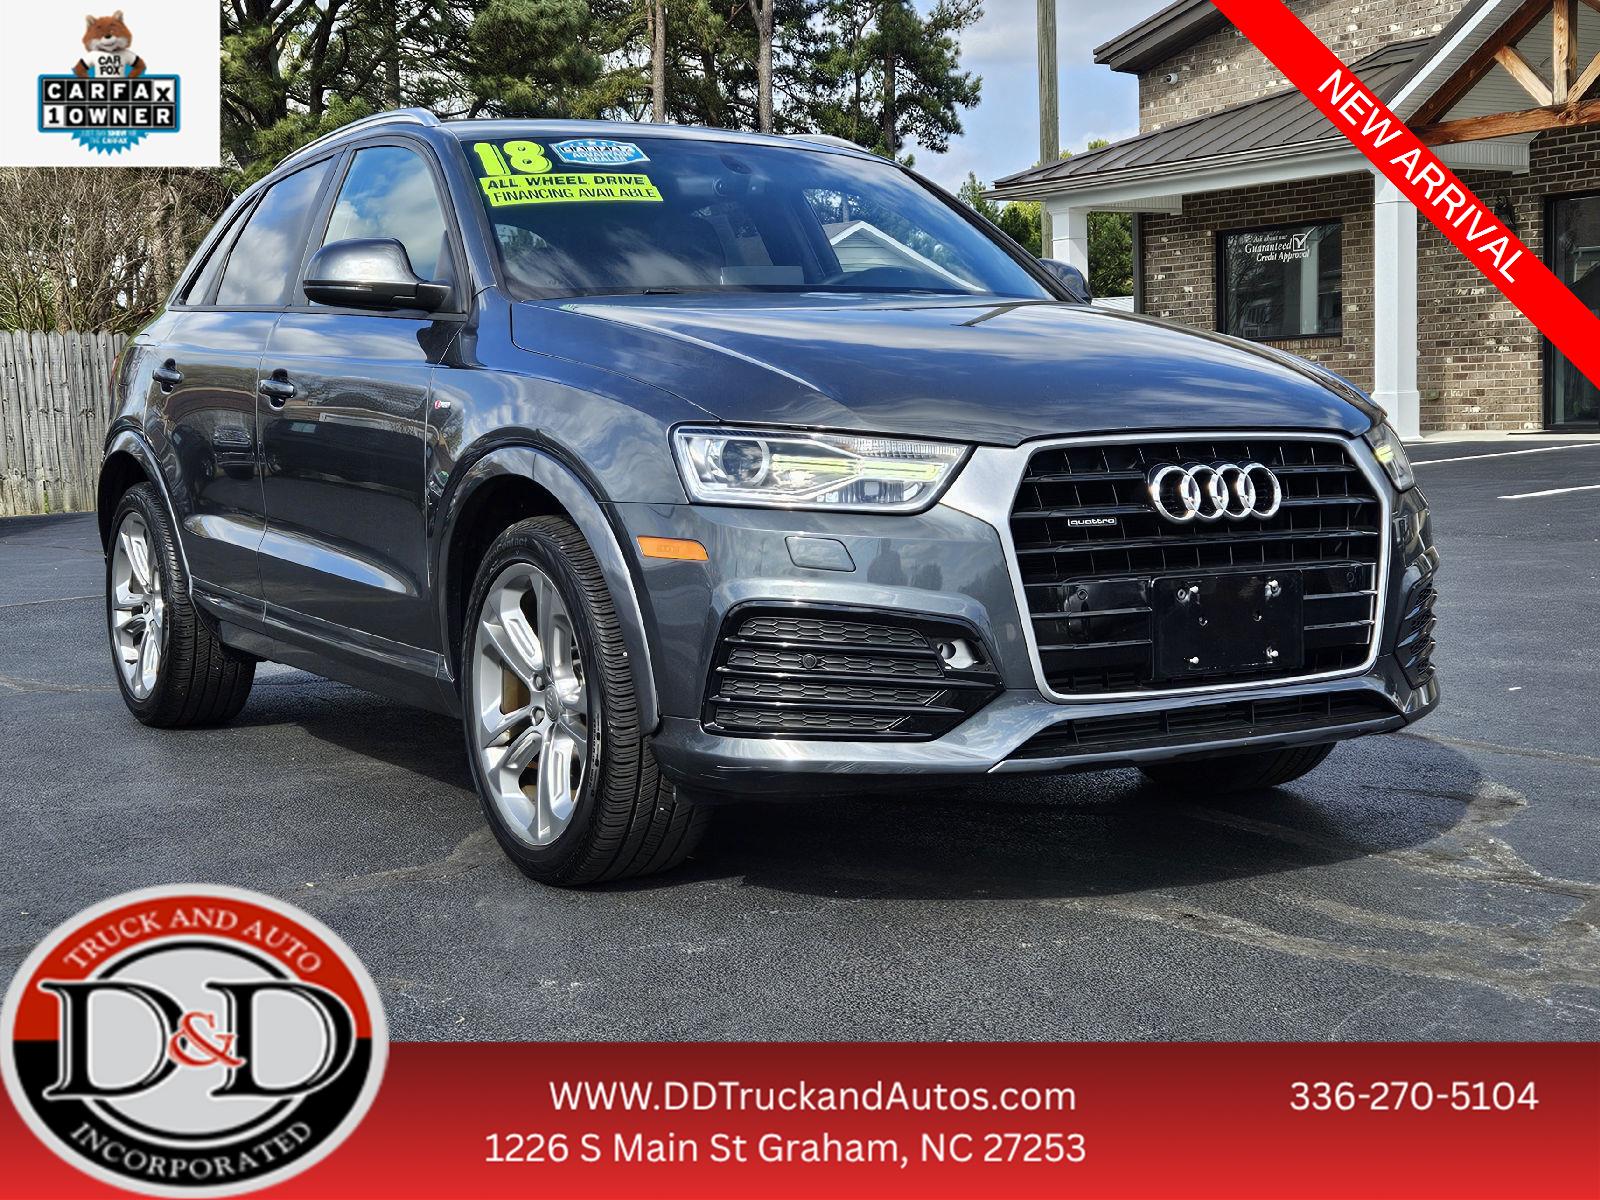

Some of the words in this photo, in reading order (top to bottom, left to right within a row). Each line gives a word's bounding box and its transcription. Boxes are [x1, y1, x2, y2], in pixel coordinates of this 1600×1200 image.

[473, 140, 553, 176] 18
[487, 179, 518, 189] ALL
[524, 177, 587, 188] WHEEL
[593, 175, 645, 186] DRIVE
[493, 189, 574, 203] FINANCING
[578, 188, 656, 198] AVAILABLE
[1245, 238, 1292, 253] Guaranteed
[1256, 252, 1277, 262] Credit
[1278, 248, 1310, 262] Approval
